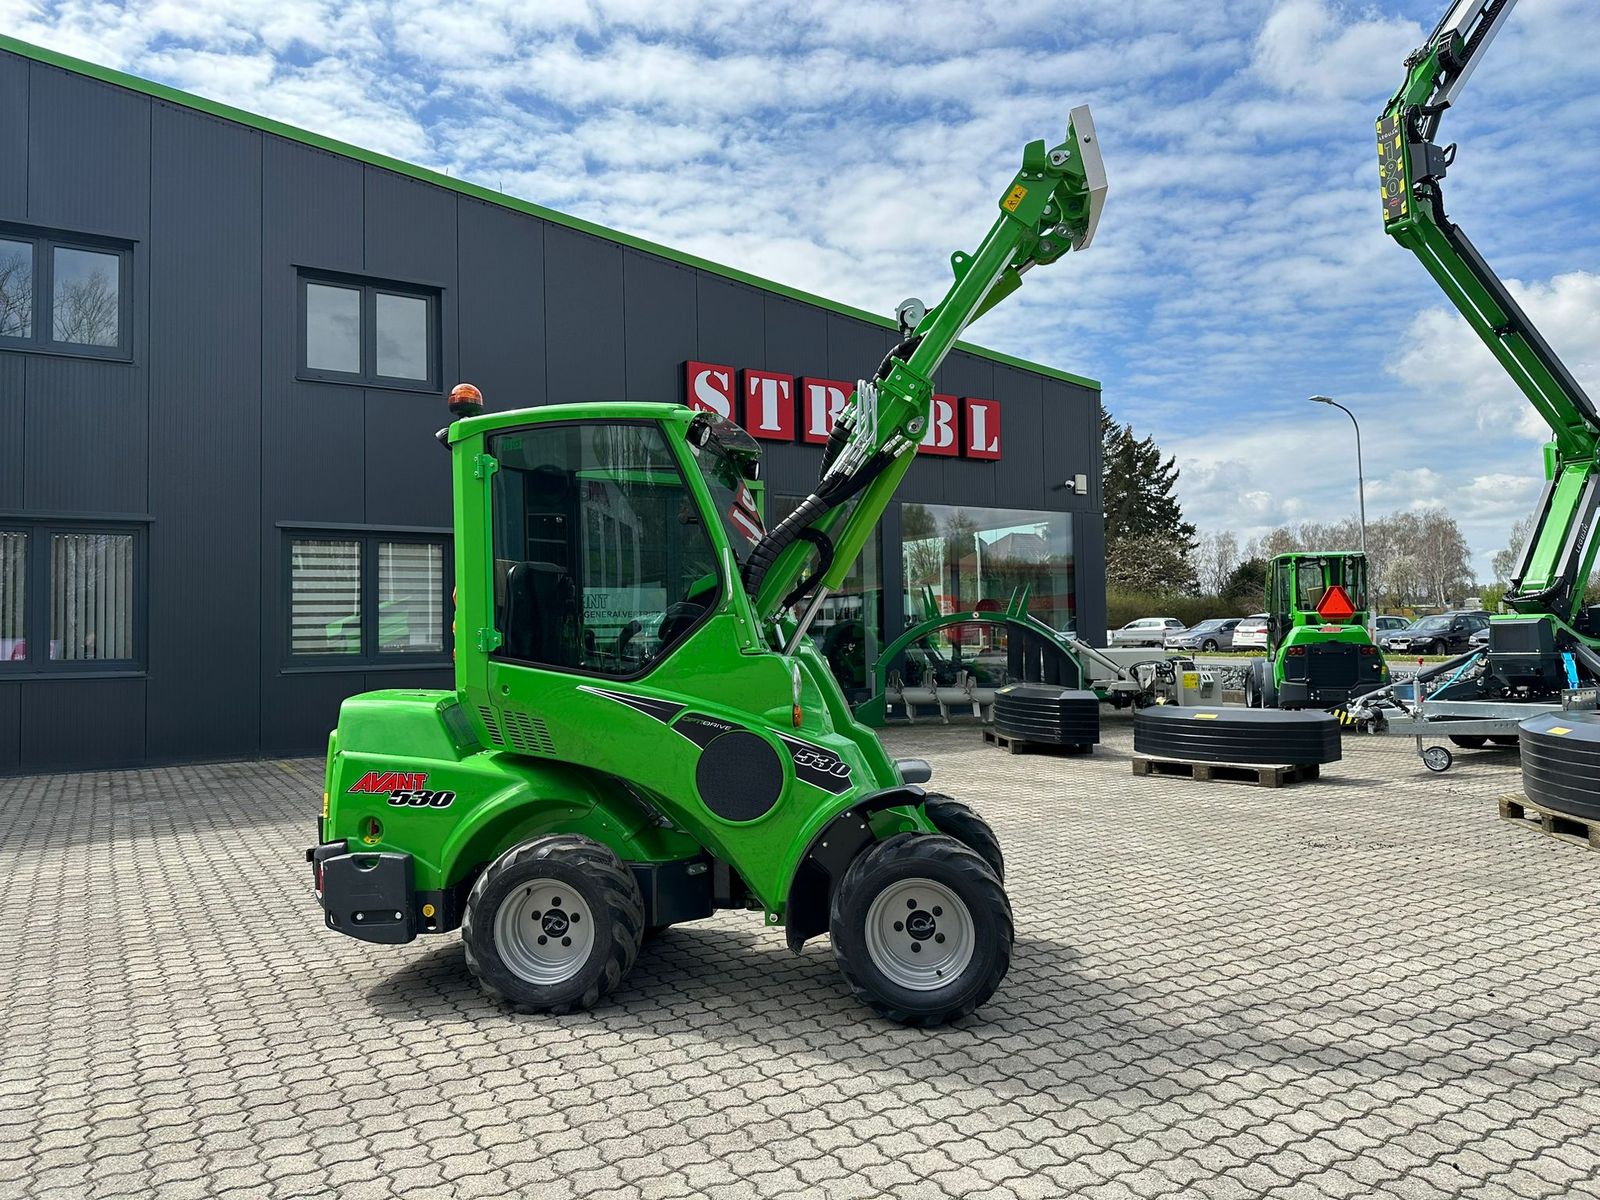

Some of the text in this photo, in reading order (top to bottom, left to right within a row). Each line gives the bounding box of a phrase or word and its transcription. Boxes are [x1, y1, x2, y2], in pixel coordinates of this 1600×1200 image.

[1384, 141, 1399, 197] 190
[694, 370, 998, 452] STRBL
[793, 748, 852, 777] 530
[347, 769, 428, 794] AVANT
[386, 790, 456, 809] 530
